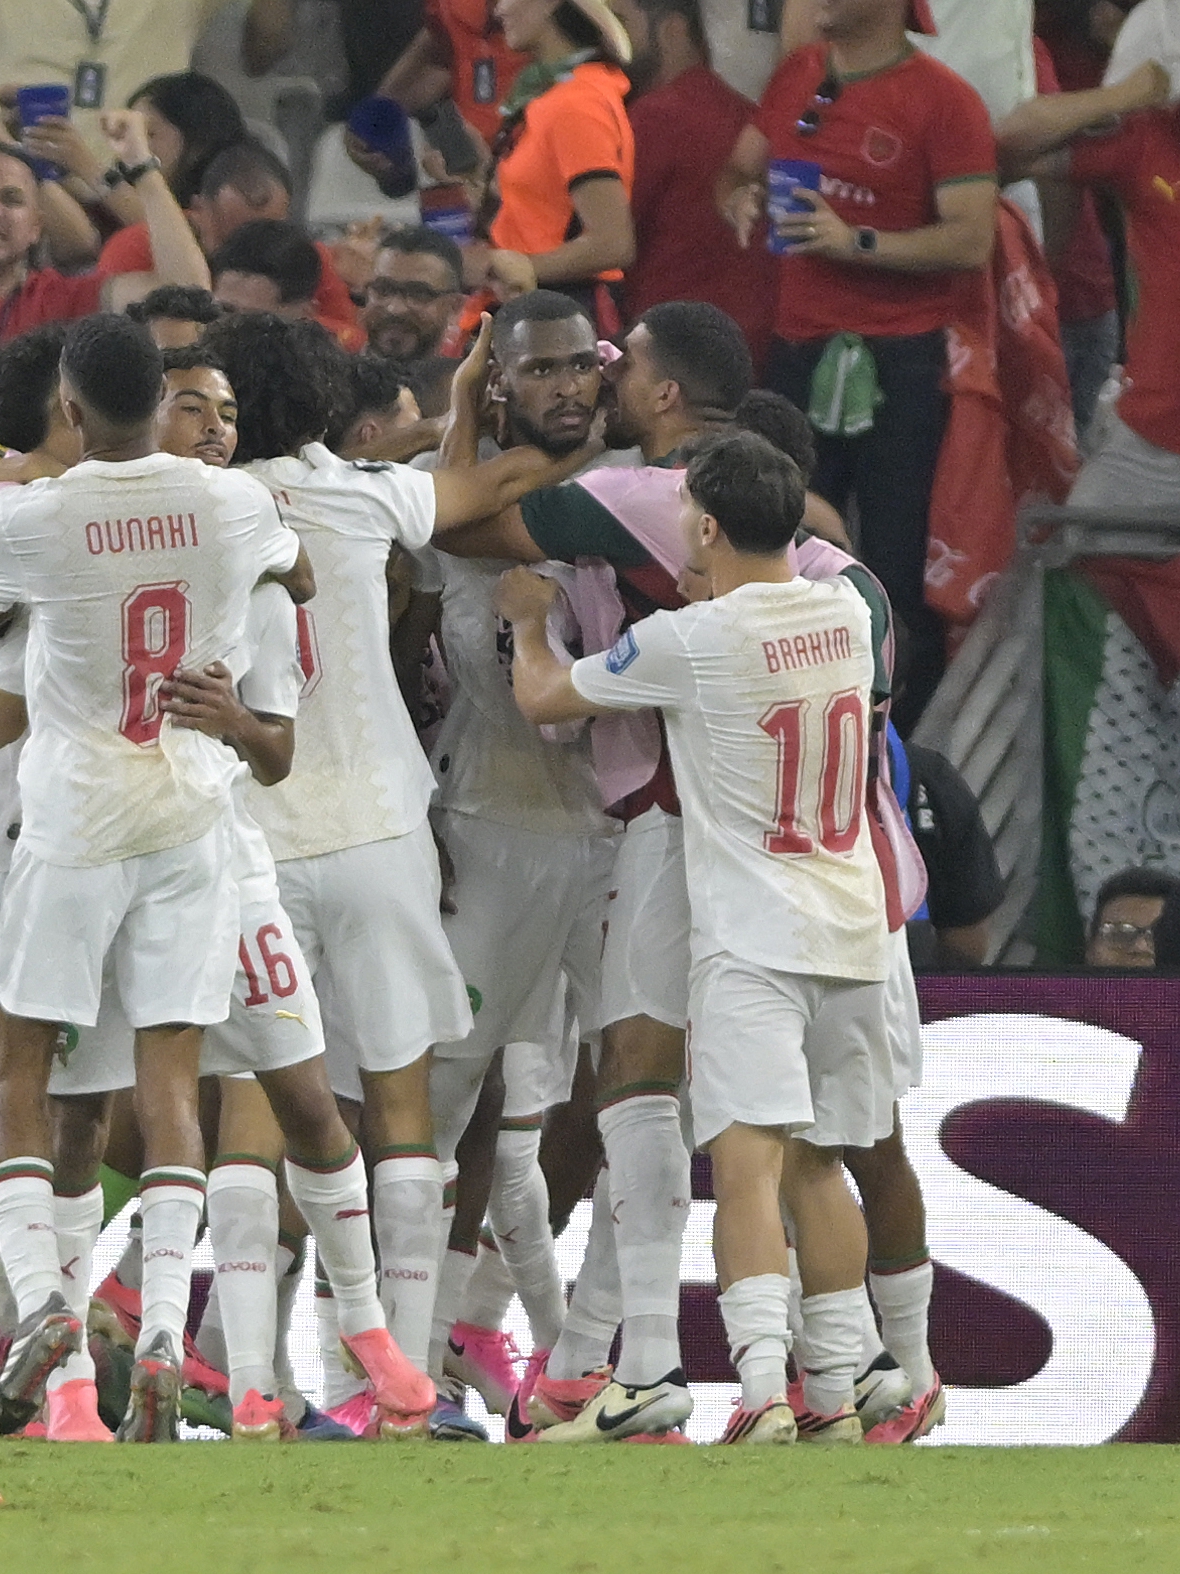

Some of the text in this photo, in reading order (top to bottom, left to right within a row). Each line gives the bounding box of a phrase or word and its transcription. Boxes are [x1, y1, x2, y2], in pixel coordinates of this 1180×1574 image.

[85, 513, 199, 555] OUNAHI
[119, 579, 193, 749] 8
[762, 626, 851, 674] BRAHIM
[756, 686, 866, 860] 10
[238, 922, 299, 1007] 16
